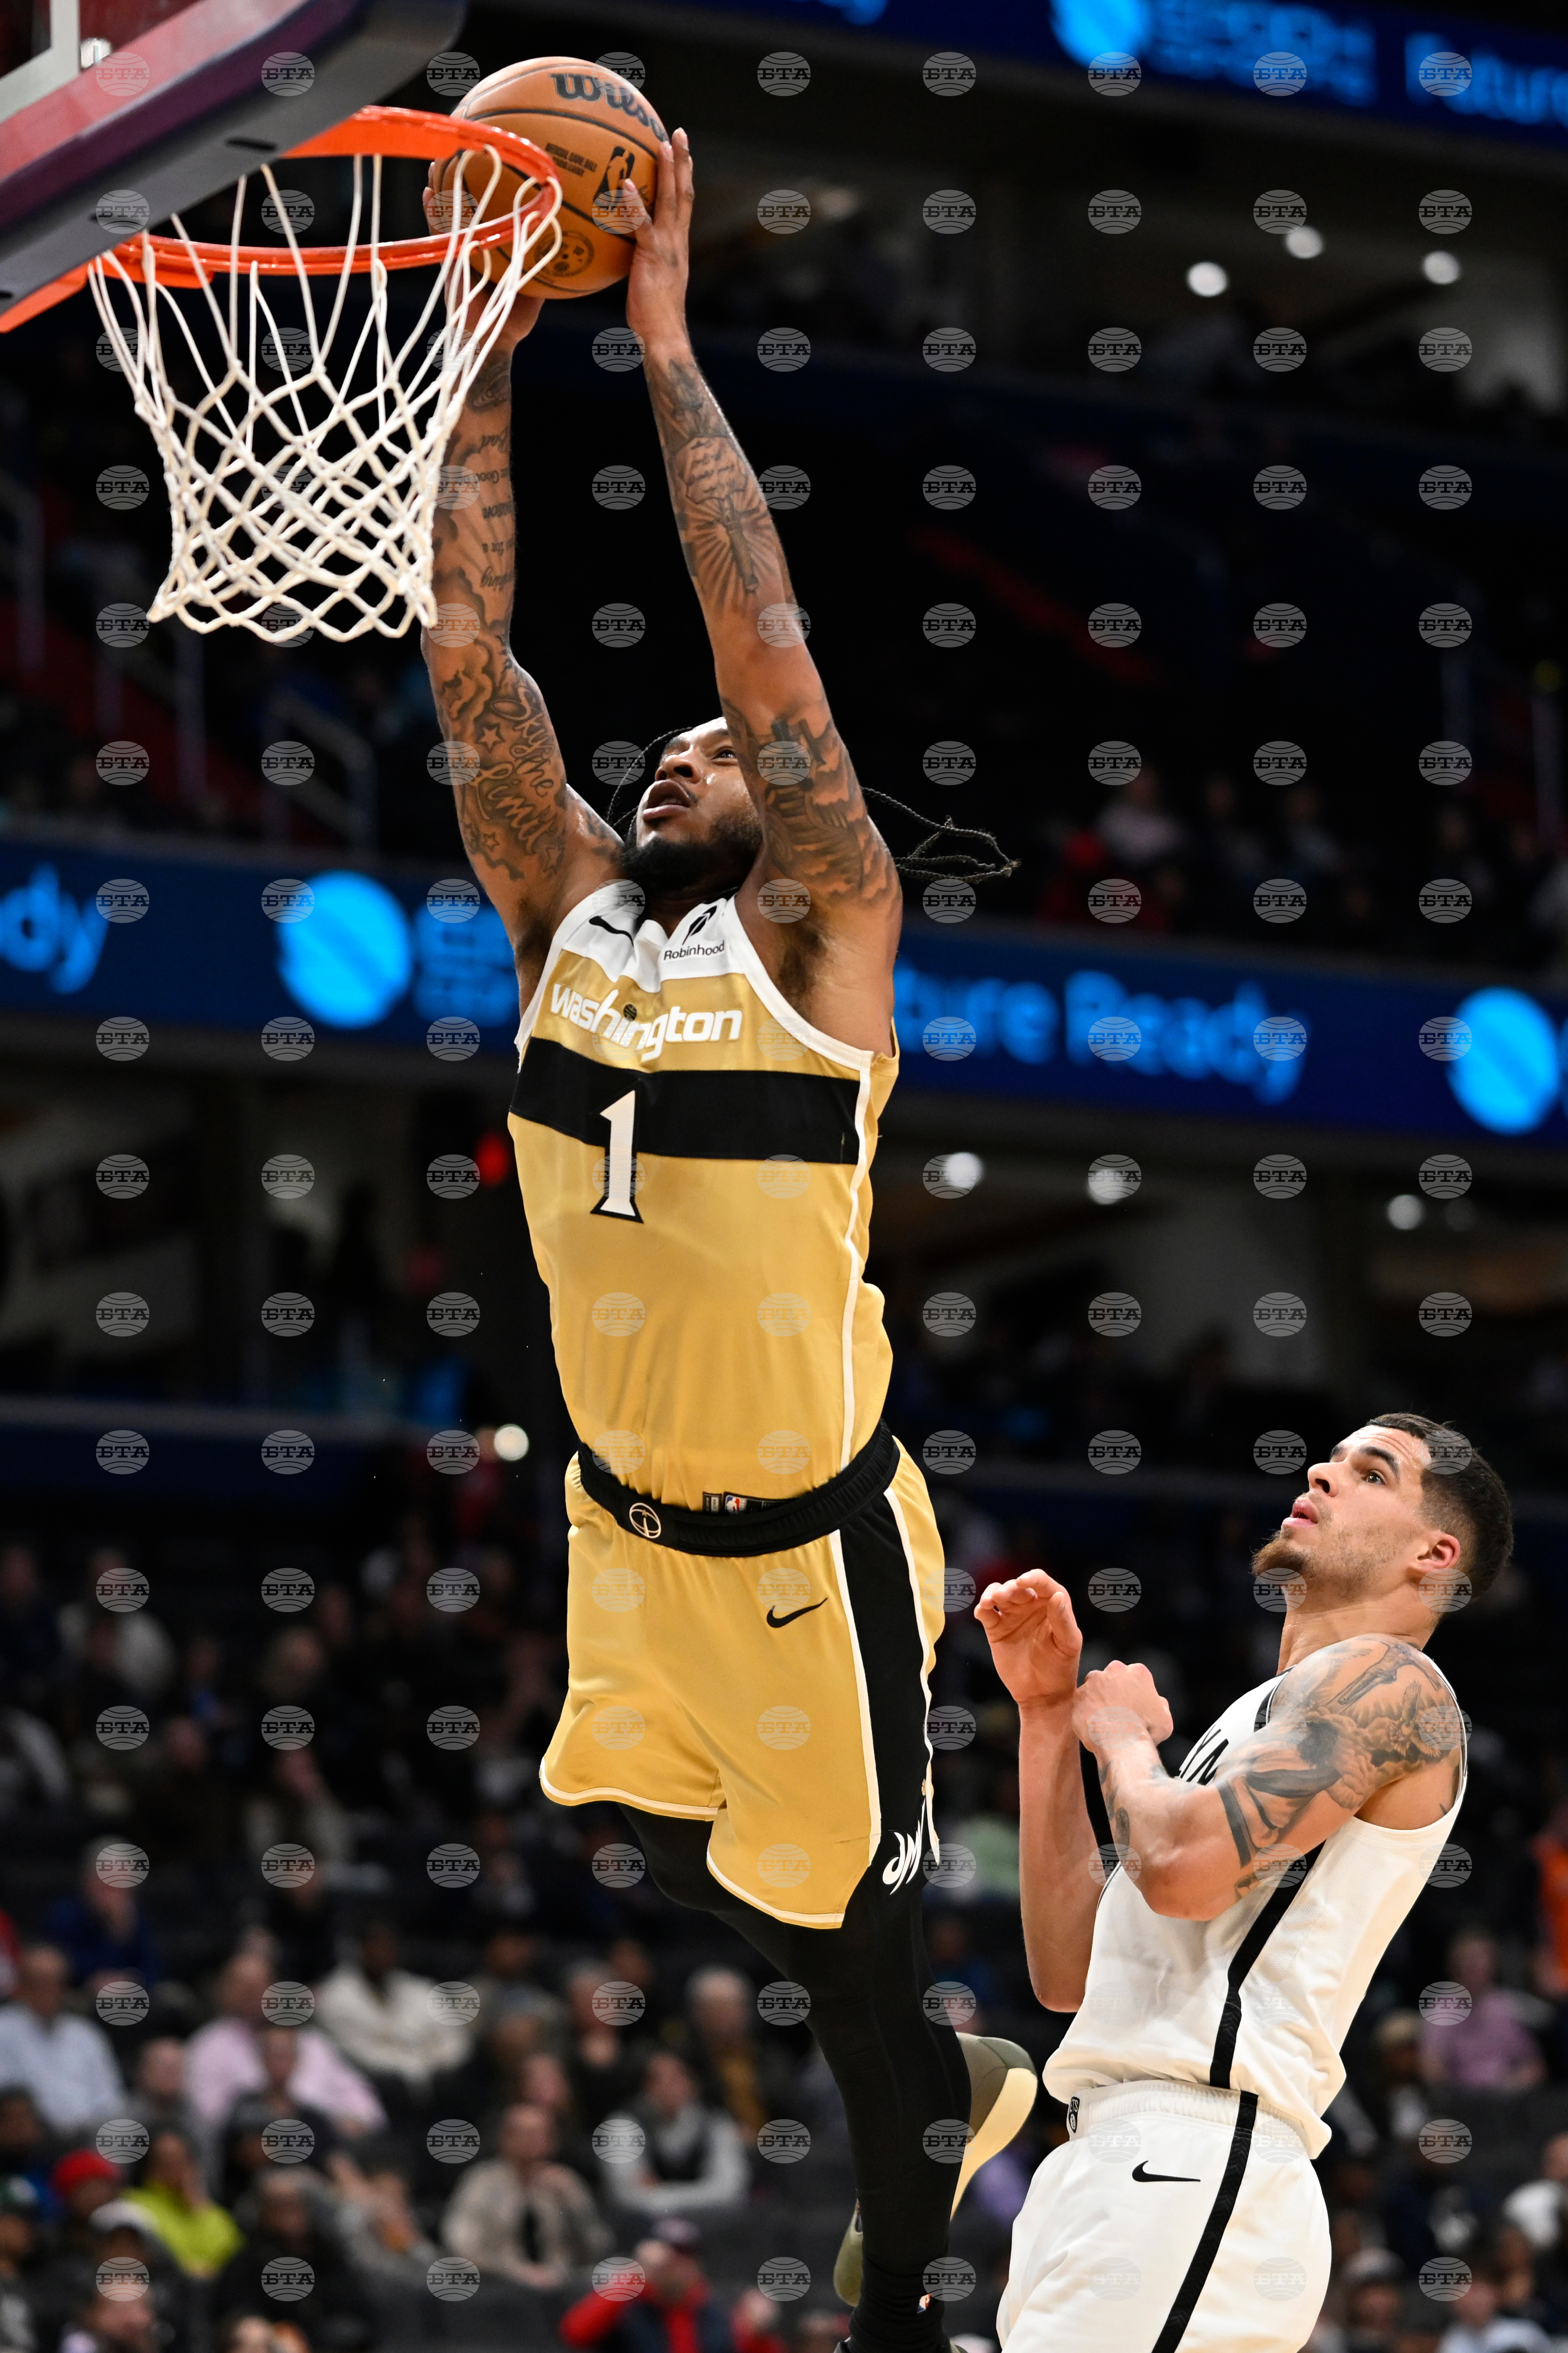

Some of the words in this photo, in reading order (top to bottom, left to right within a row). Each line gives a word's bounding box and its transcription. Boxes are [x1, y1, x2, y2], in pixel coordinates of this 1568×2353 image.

[663, 939, 725, 961] Robinhood
[551, 983, 743, 1062] washington
[592, 1086, 642, 1221] 1
